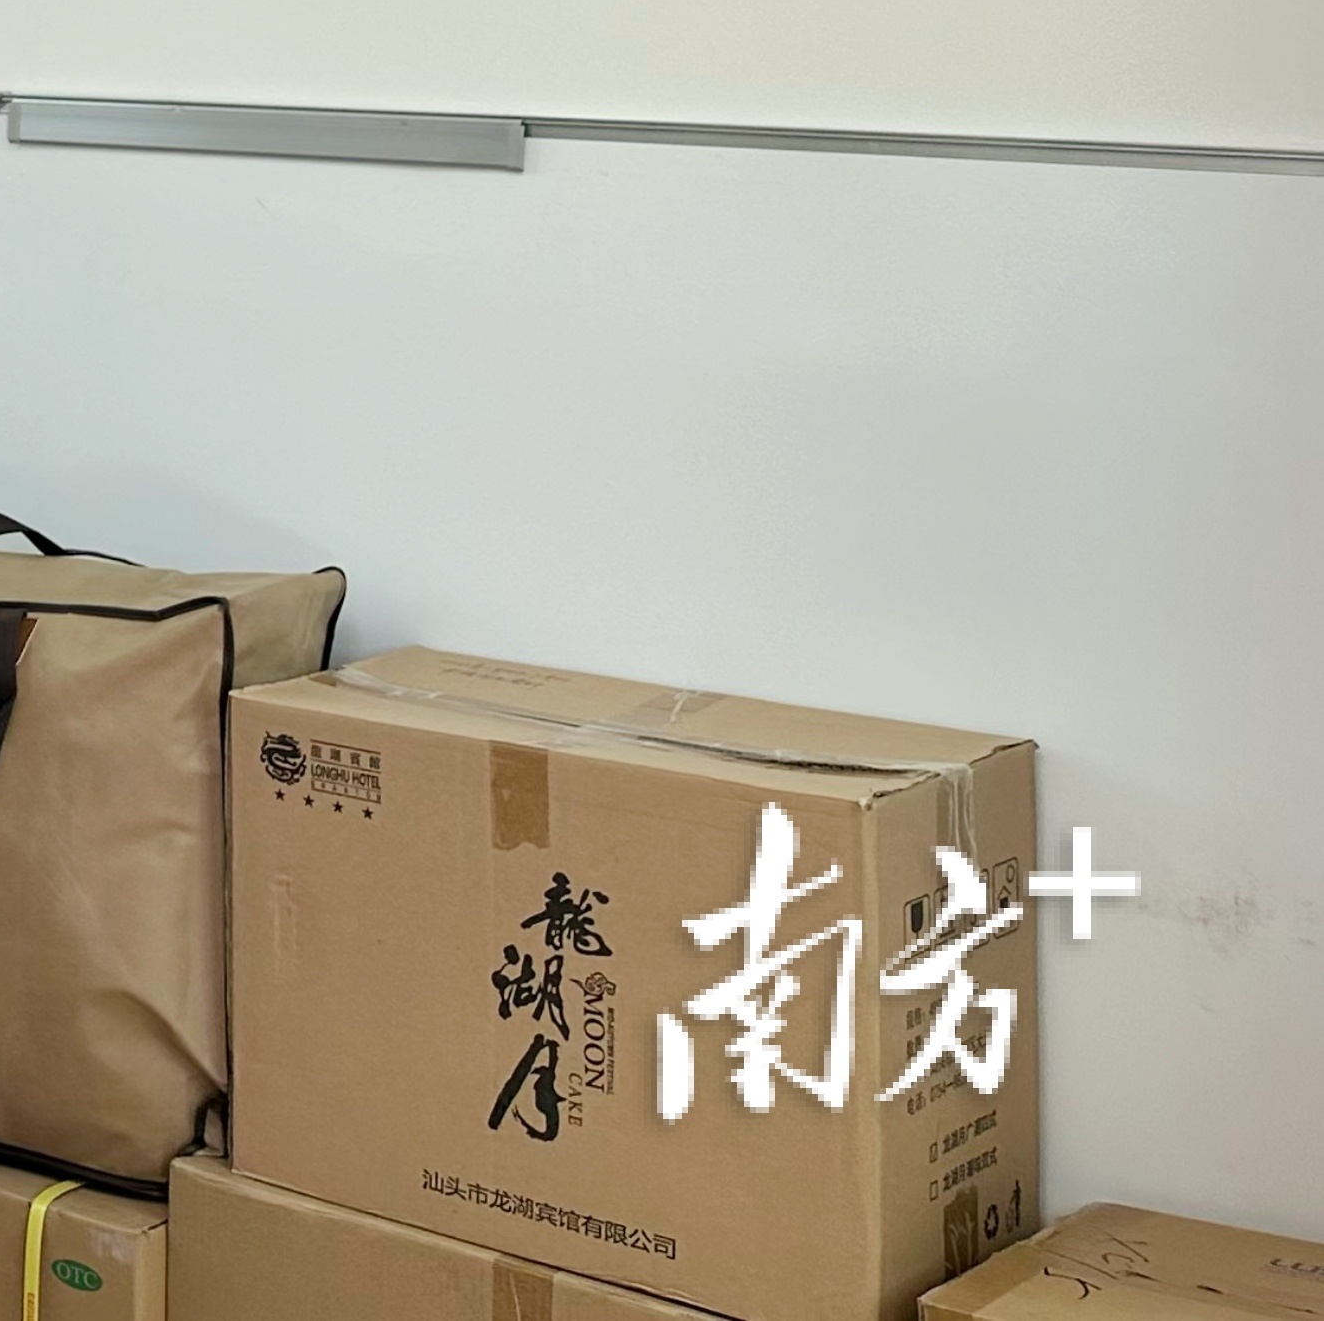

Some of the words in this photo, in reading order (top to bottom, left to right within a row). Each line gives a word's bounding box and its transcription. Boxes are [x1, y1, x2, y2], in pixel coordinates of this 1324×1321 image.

[352, 770, 382, 790] HOTEL
[582, 991, 607, 1093] MOON
[567, 1071, 584, 1128] CAKE
[421, 1168, 677, 1260] 汕头市龙湖宾馆有限公司
[56, 1261, 98, 1290] OTC
